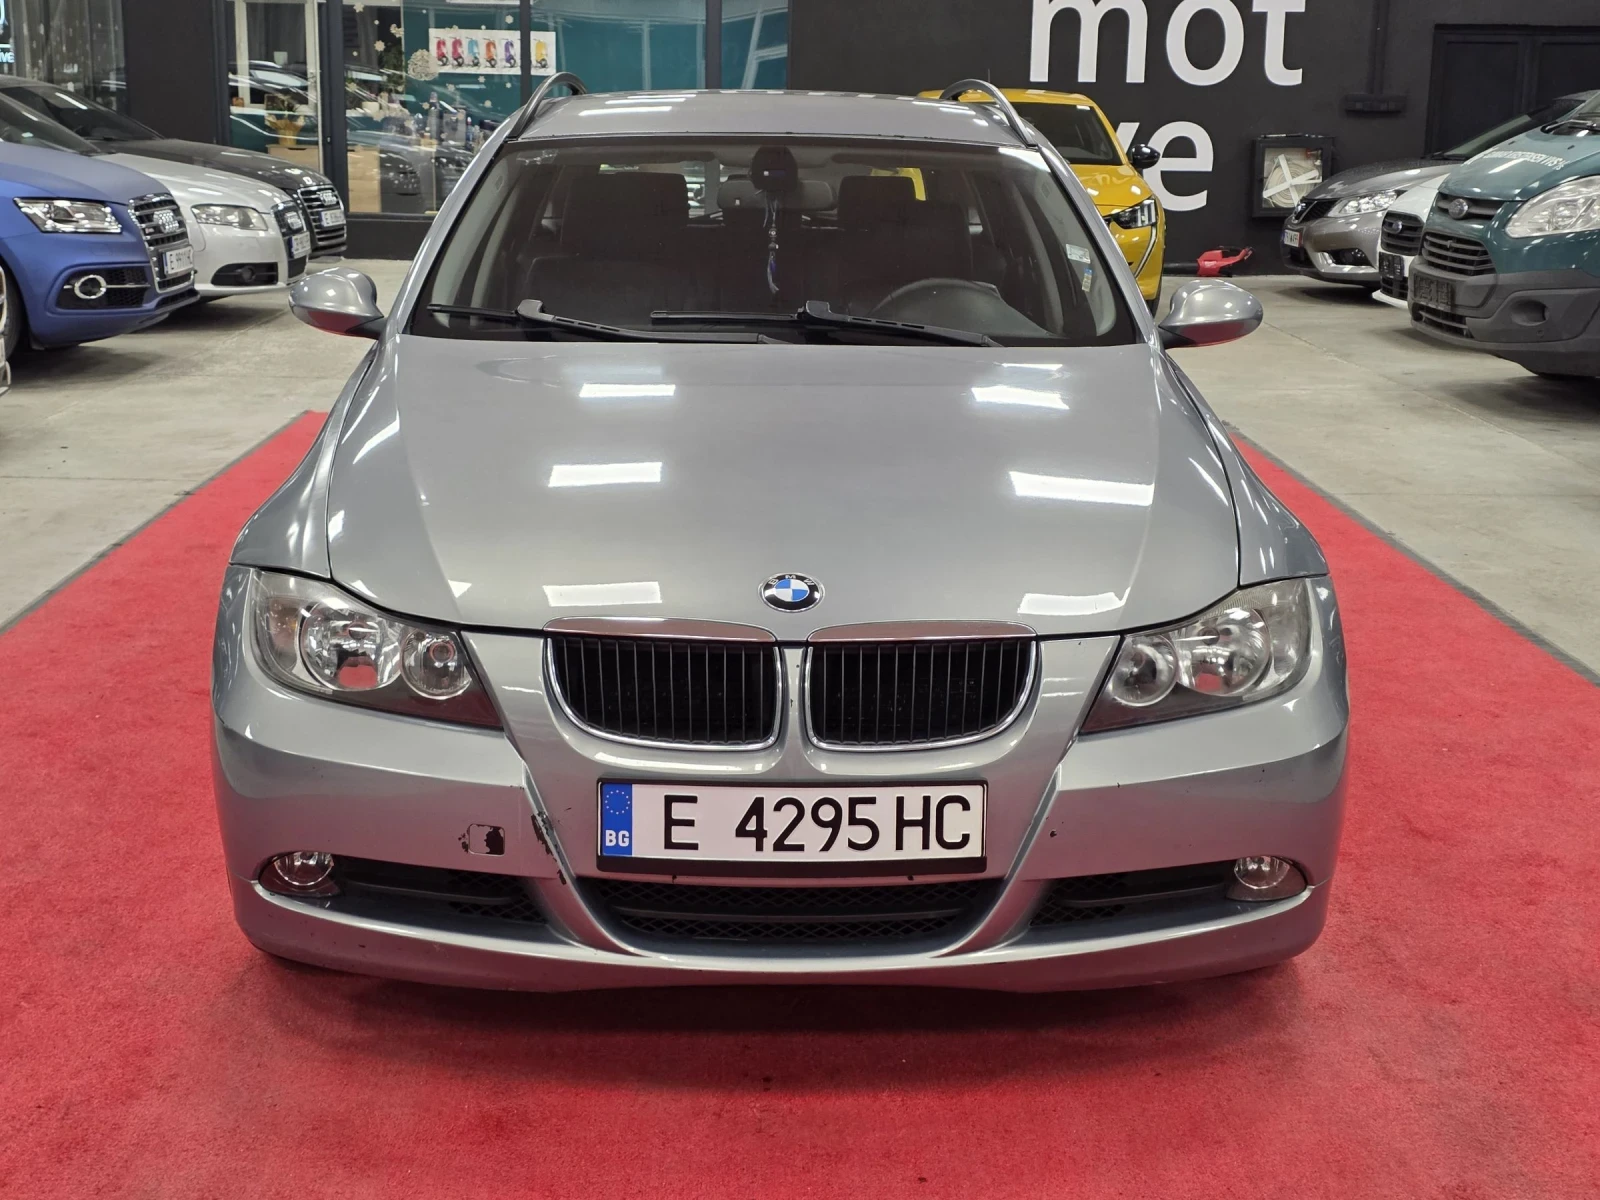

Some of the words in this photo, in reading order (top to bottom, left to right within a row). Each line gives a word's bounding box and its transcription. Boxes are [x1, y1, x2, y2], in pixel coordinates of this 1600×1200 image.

[1029, 0, 1303, 87] mot
[768, 574, 815, 586] BMW
[605, 829, 630, 847] BG
[663, 794, 699, 851] E
[735, 796, 880, 852] 4295
[895, 794, 971, 851] HC
